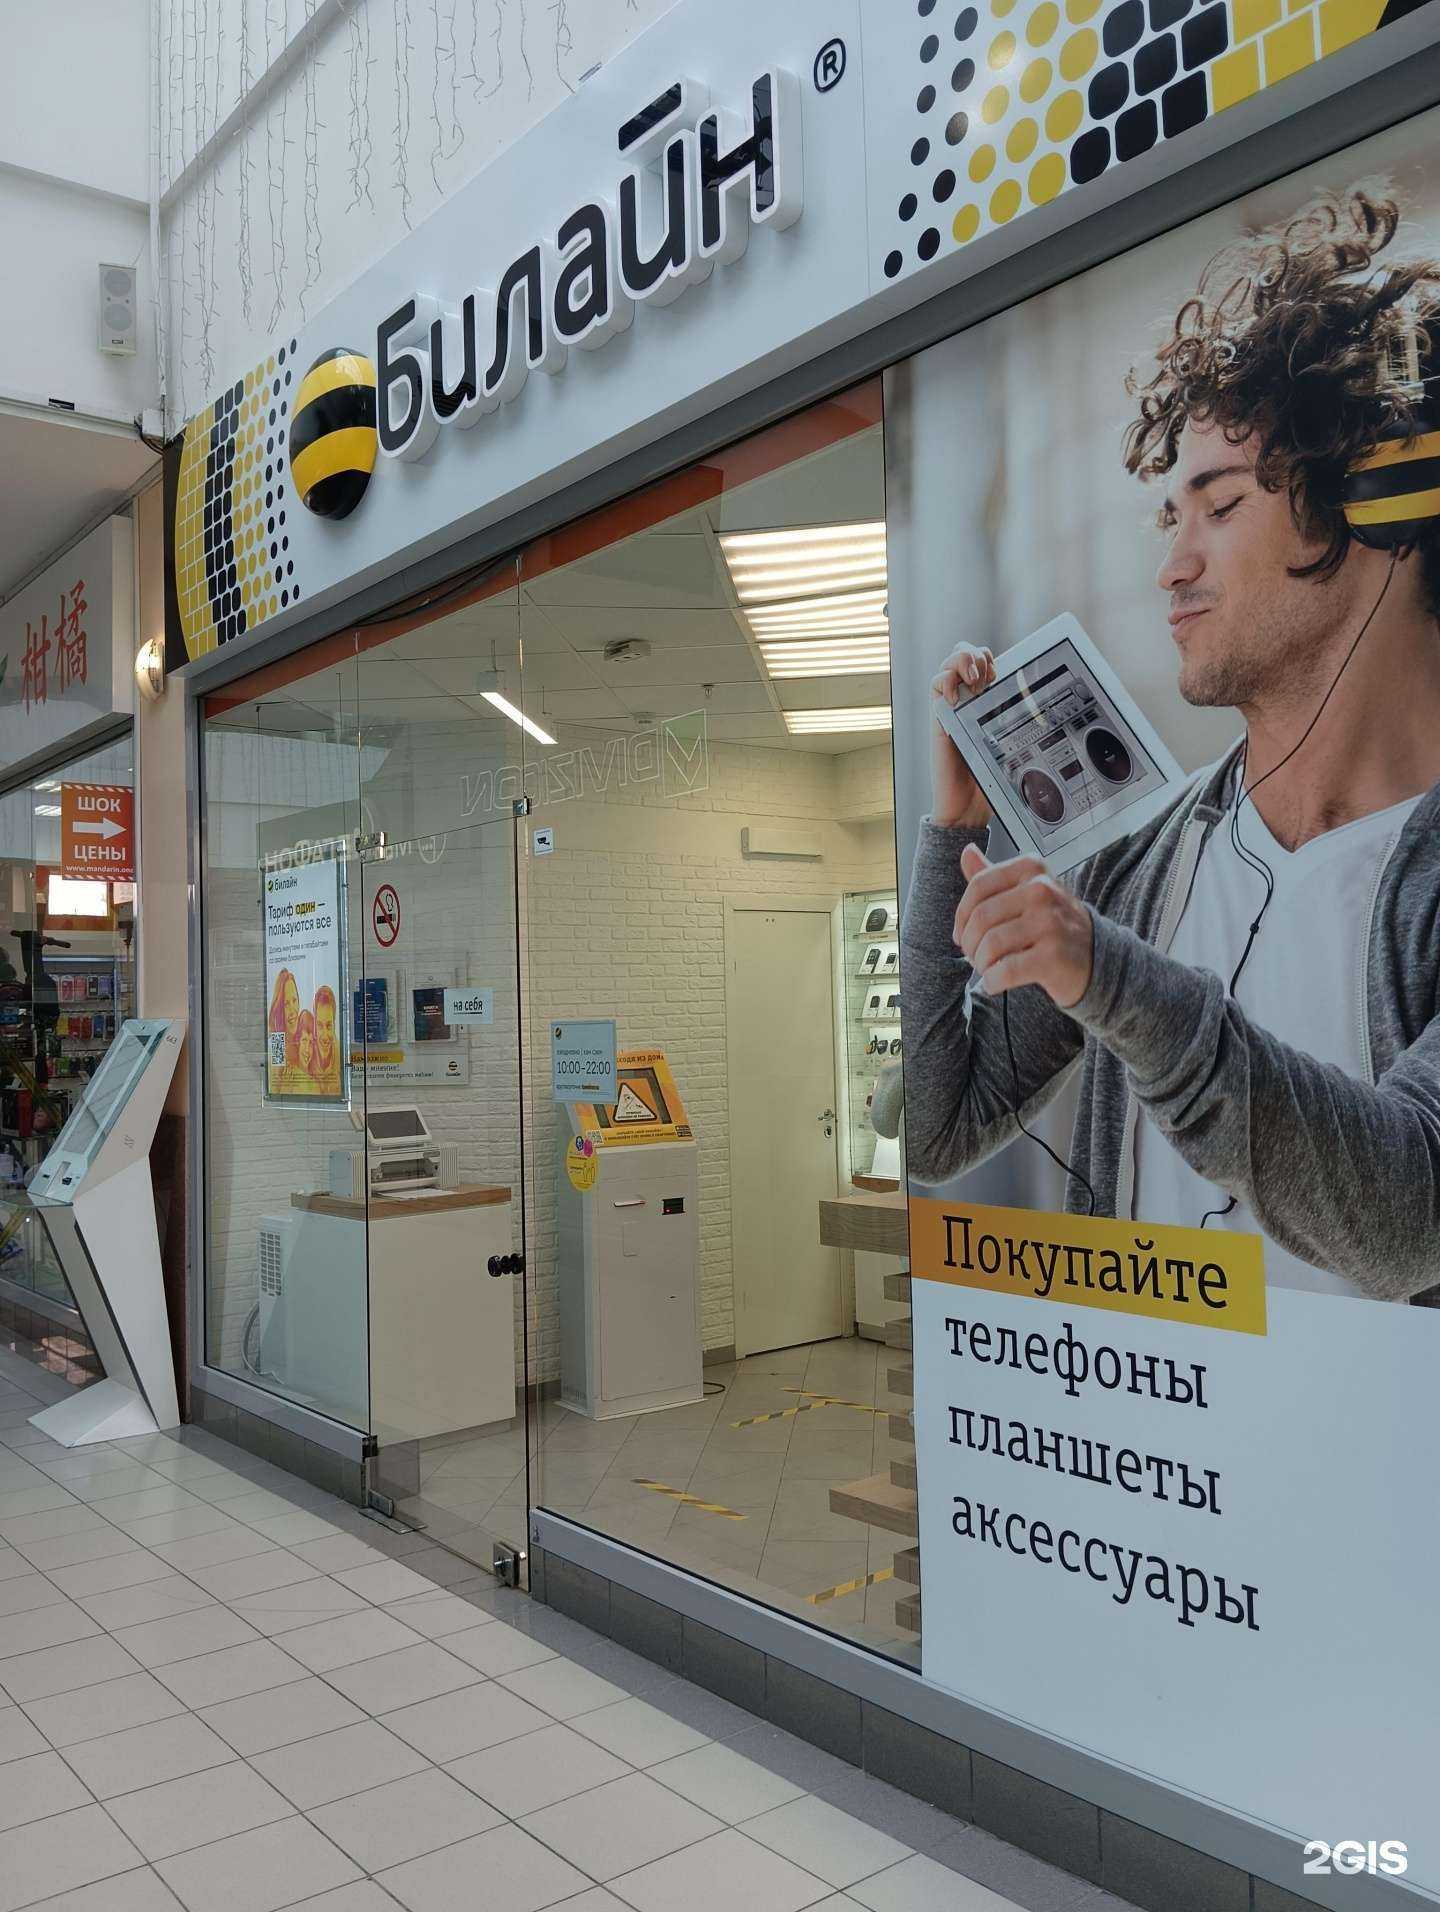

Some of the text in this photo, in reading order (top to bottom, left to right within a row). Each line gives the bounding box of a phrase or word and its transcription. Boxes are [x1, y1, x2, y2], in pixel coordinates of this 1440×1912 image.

[375, 70, 778, 455] Билайн
[78, 796, 121, 812] ШОК
[74, 844, 126, 861] ЦЕНЫ
[274, 876, 298, 891] билайн
[268, 902, 294, 922] Тариф
[295, 901, 316, 917] один
[268, 916, 332, 937] пользуются все
[453, 997, 483, 1011] на себя
[942, 1214, 1228, 1309] Покупайте
[945, 1317, 1208, 1408] телефоны
[948, 1405, 1222, 1515] планшеты
[952, 1495, 1261, 1631] аксессуары
